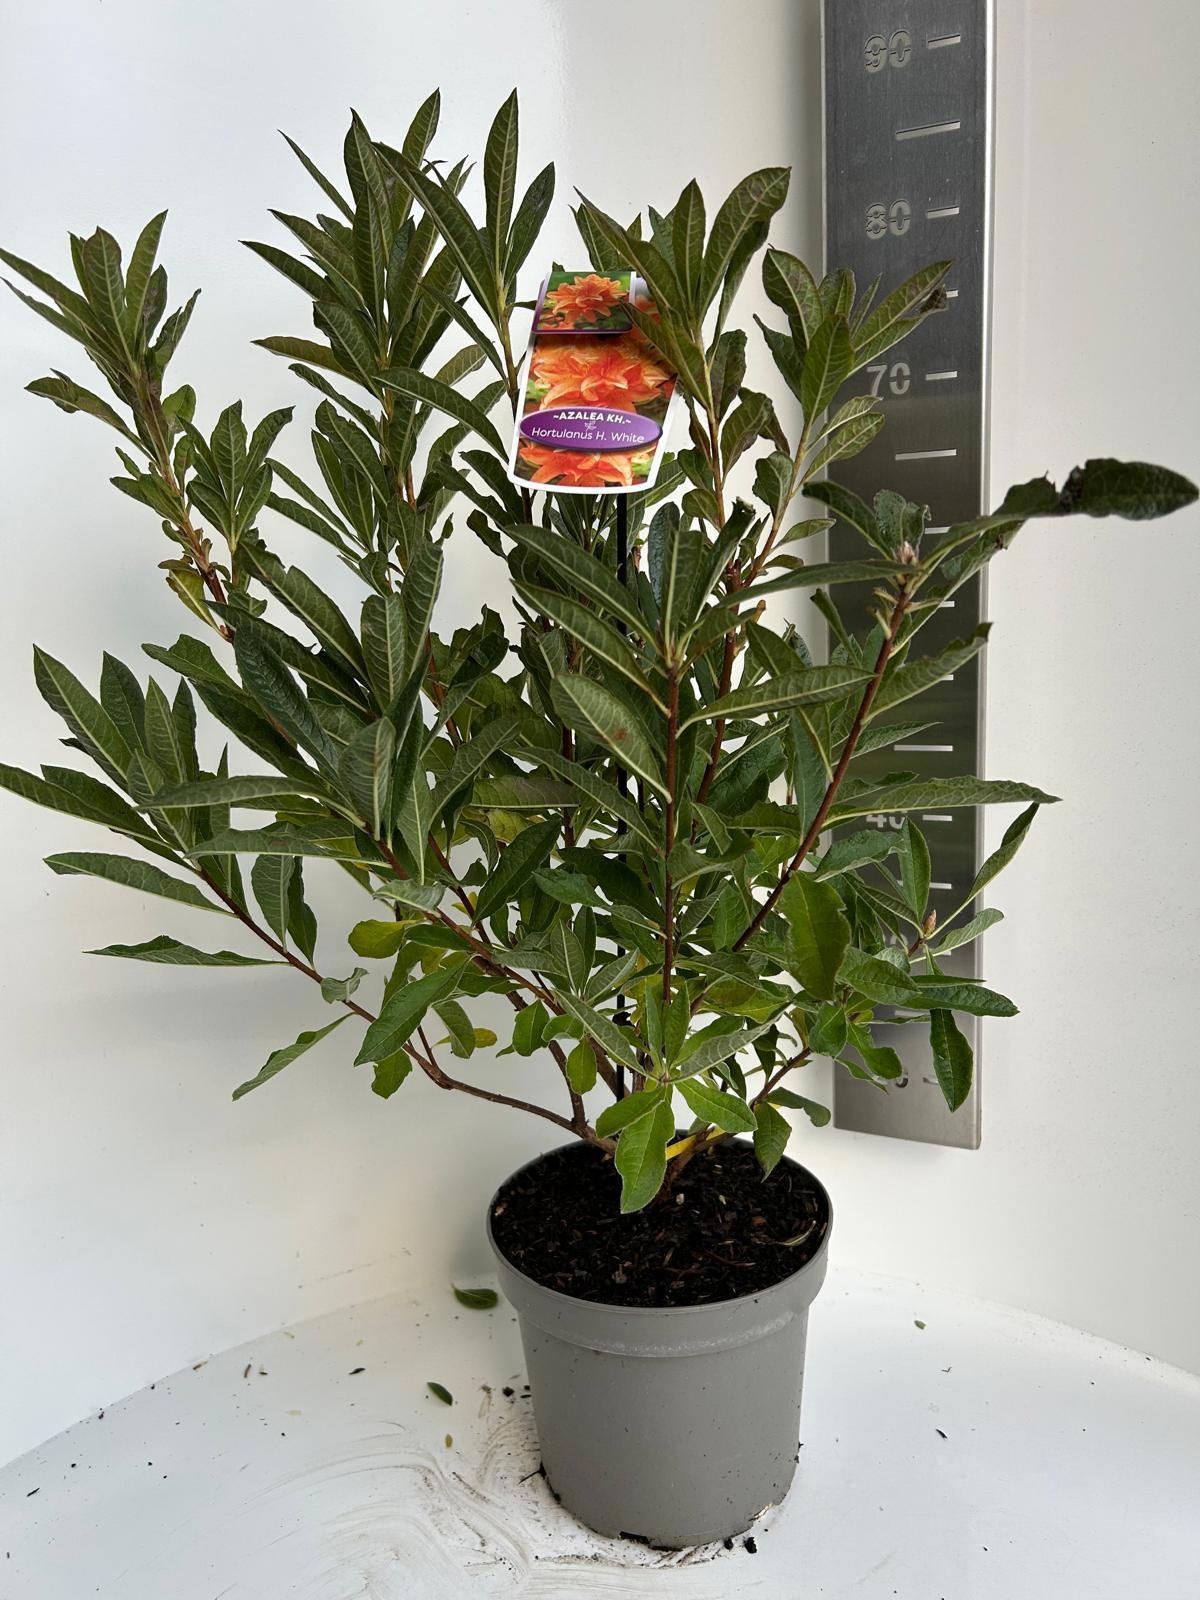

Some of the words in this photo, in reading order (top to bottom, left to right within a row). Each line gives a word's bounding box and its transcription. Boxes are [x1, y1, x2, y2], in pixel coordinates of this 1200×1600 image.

[864, 29, 912, 73] 90
[865, 200, 912, 239] 80
[866, 362, 911, 396] 70
[531, 427, 593, 440] Hortulanus
[595, 431, 607, 441] H.
[611, 432, 645, 443] White
